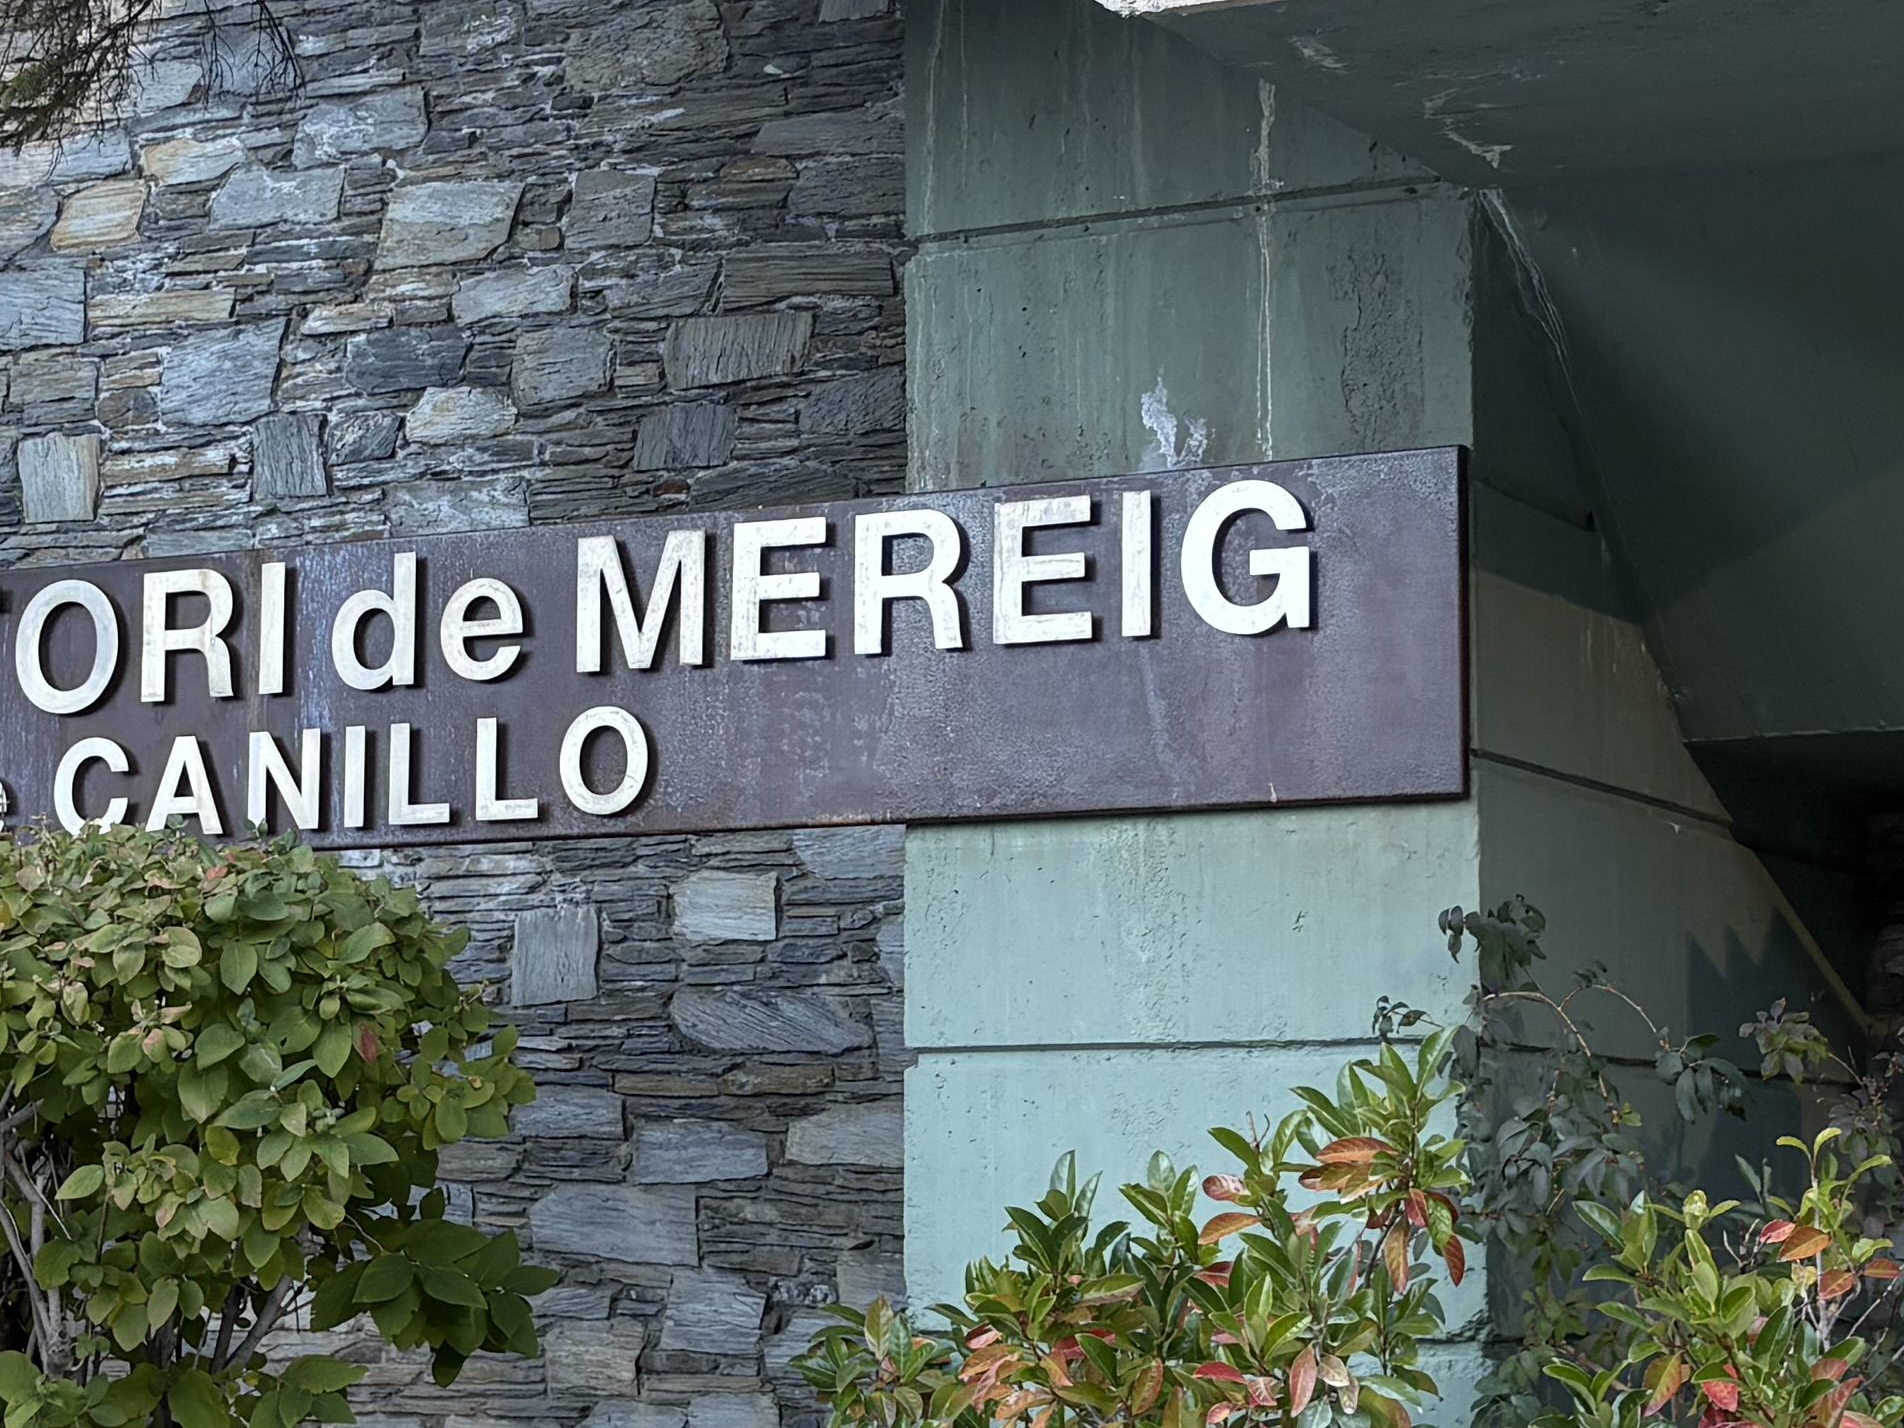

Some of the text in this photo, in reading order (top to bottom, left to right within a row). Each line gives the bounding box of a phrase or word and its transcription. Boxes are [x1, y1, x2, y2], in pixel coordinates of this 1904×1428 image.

[331, 551, 523, 691] de
[576, 479, 1311, 673] MEREIG
[53, 705, 649, 840] CANILLO
